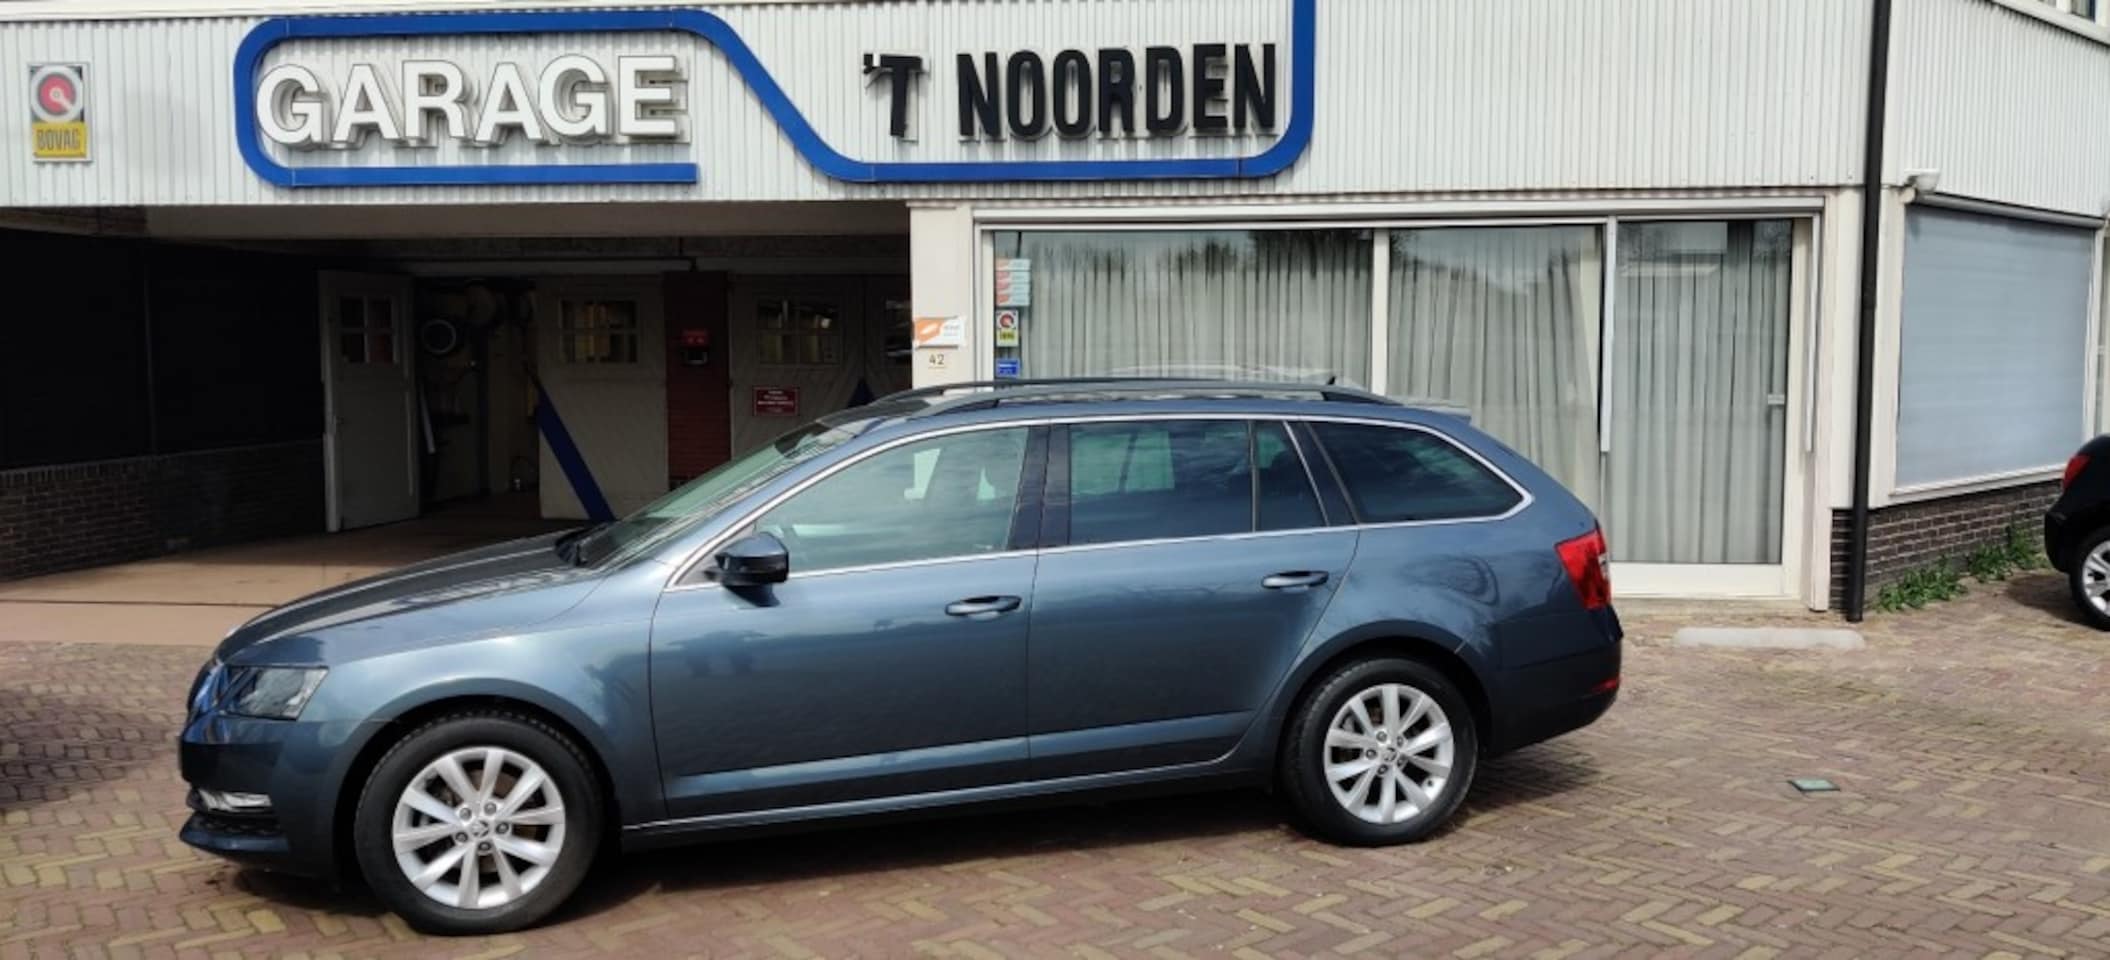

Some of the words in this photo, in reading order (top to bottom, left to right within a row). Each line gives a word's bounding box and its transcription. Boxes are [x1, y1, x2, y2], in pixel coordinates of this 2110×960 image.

[256, 54, 684, 145] GARAGE
[956, 43, 1277, 138] NOORDEN
[35, 127, 80, 151] BOVAG
[928, 353, 945, 367] 42
